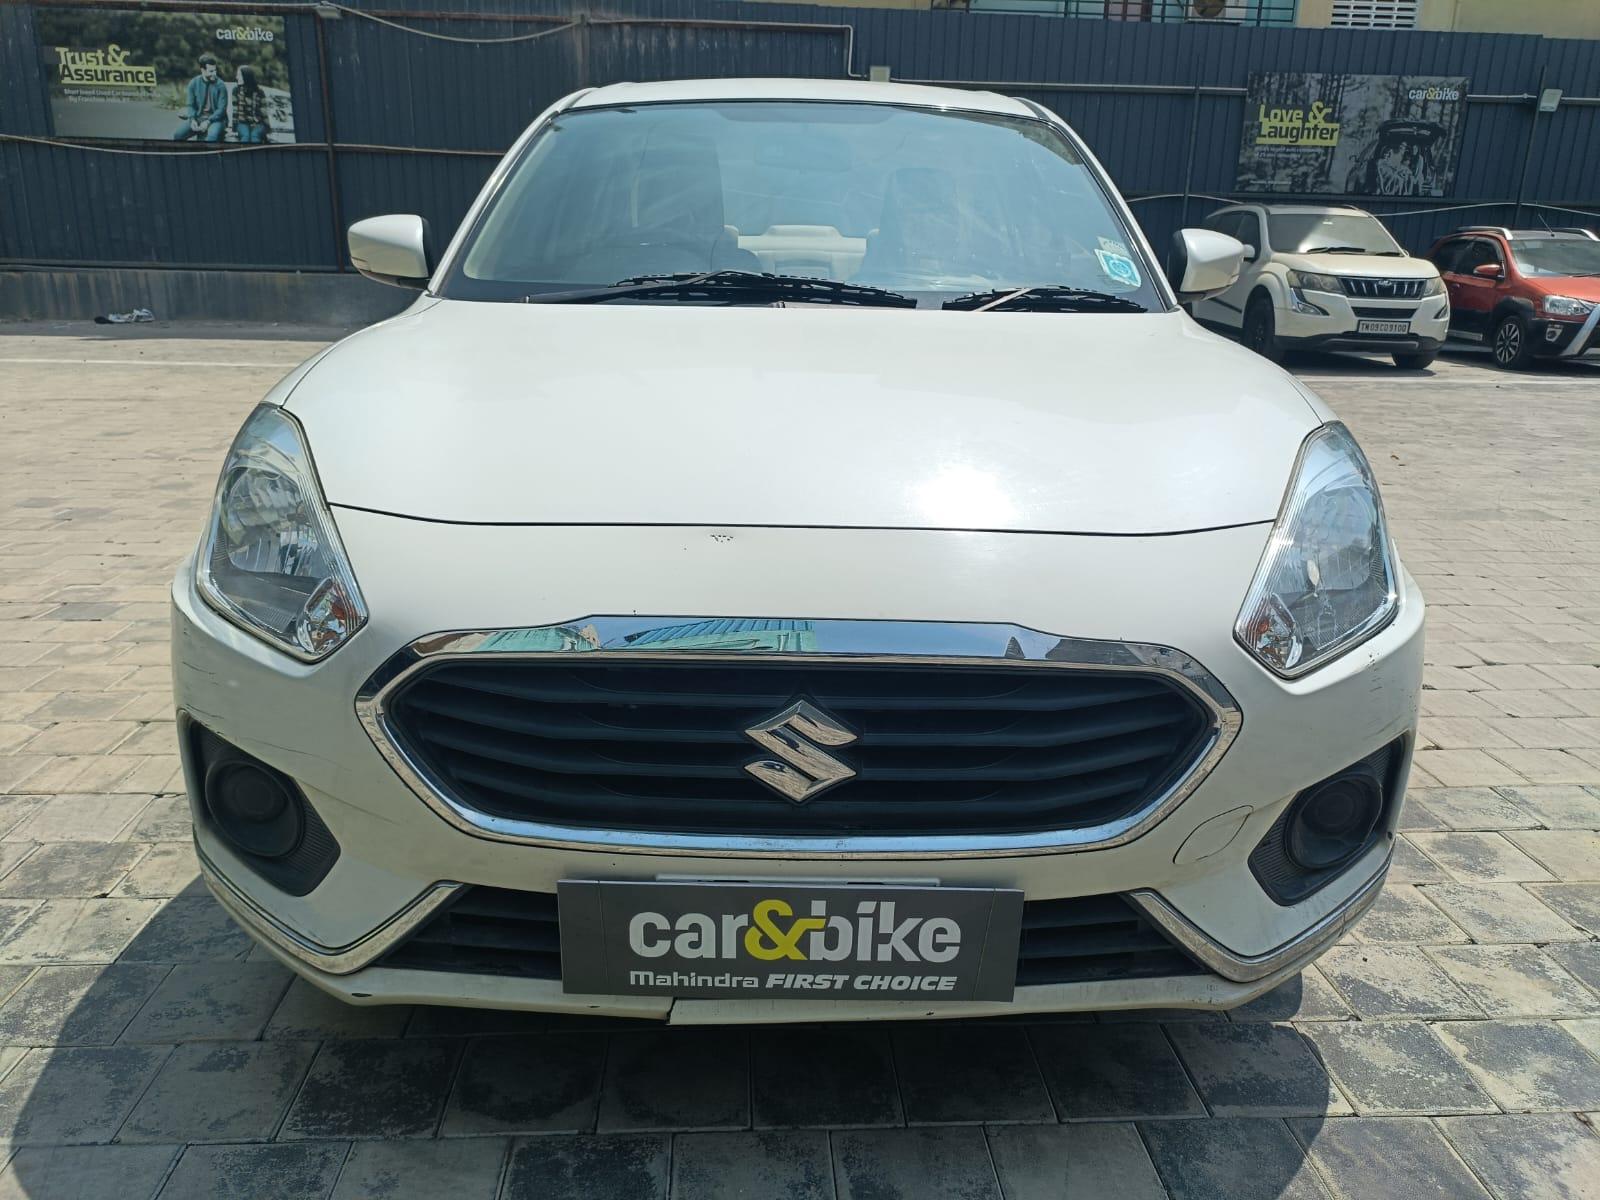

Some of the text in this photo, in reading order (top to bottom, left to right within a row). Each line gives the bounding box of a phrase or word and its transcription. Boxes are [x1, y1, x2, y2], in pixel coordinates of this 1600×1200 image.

[216, 26, 274, 42] car&bike
[55, 44, 130, 67] Trust &
[61, 65, 156, 84] Assurance
[1408, 88, 1459, 101] car&bike
[1259, 101, 1332, 124] Love &
[1257, 123, 1339, 144] Laughter
[629, 898, 962, 963] car&bike
[629, 970, 957, 992] Mahindra FIRST CHOICE
